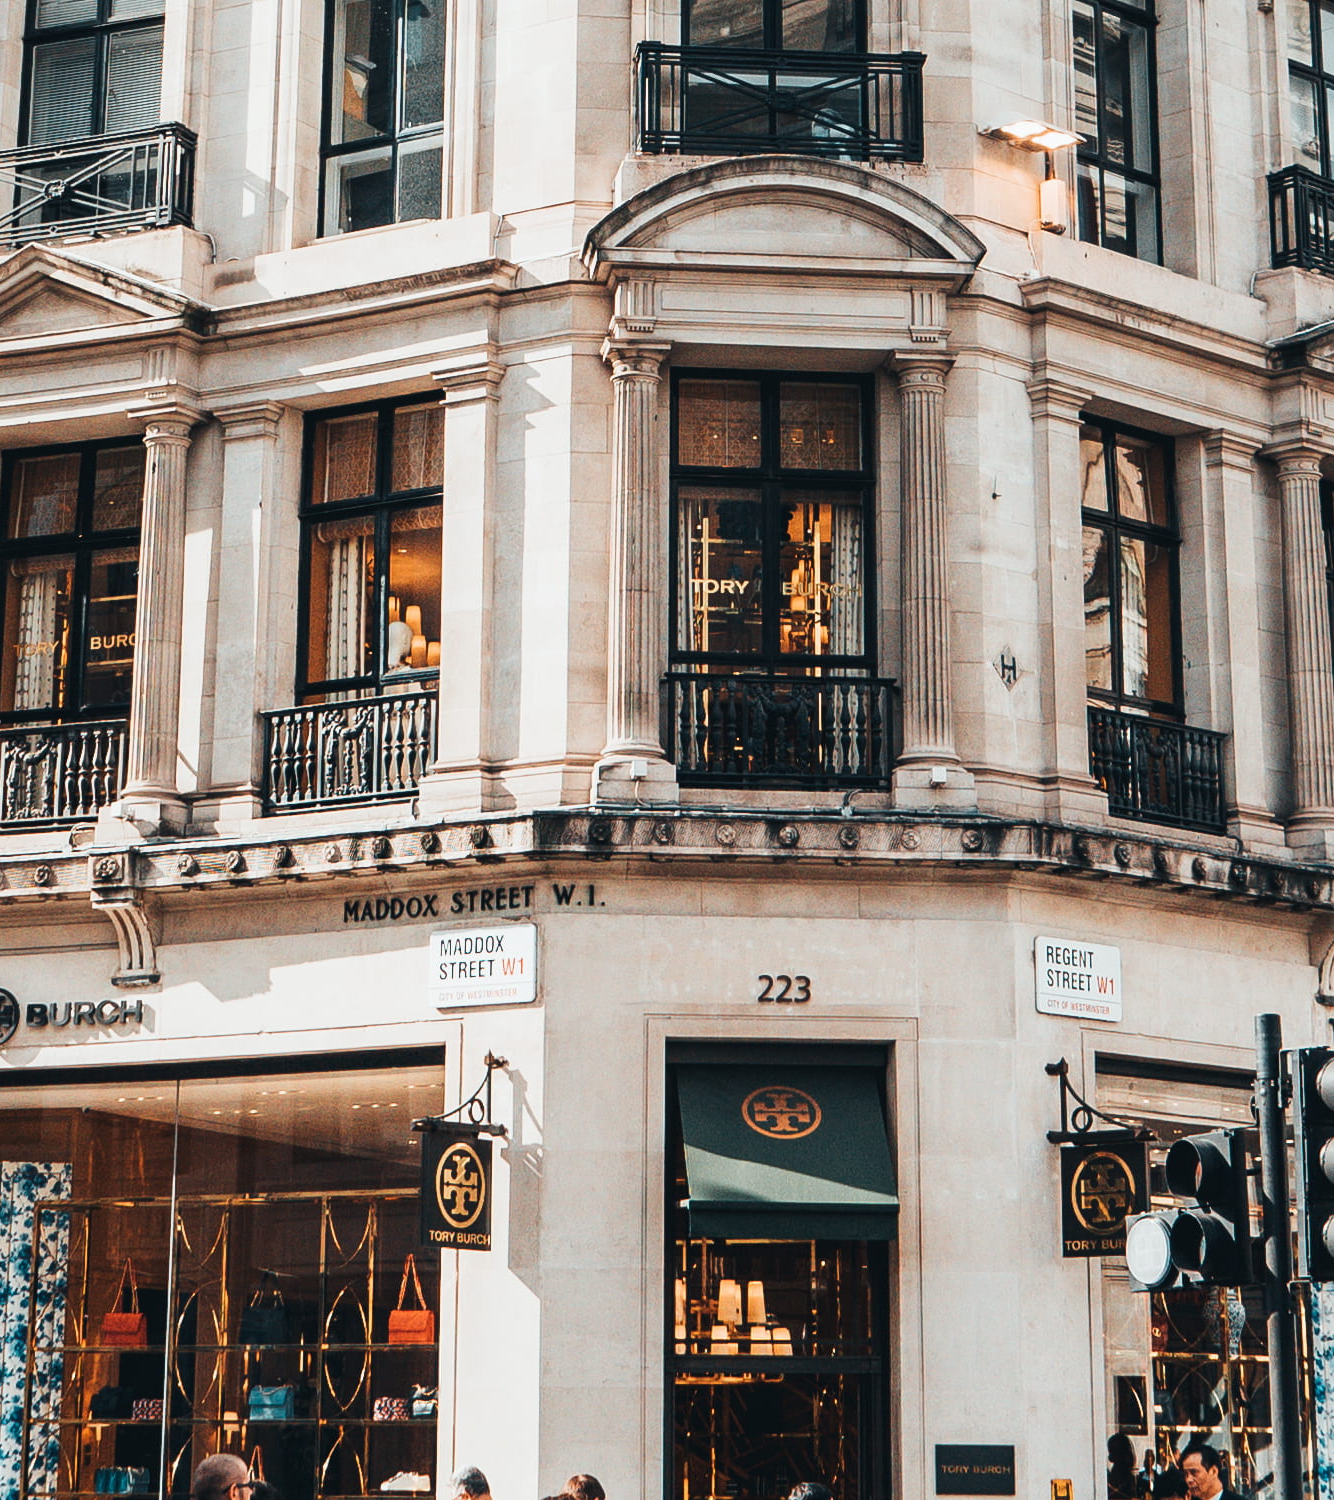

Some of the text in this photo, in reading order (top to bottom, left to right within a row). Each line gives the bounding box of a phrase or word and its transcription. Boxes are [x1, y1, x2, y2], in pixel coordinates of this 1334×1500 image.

[690, 578, 864, 598] TORY BURCH
[13, 633, 136, 657] TORY BURC
[1001, 654, 1017, 681] H
[343, 894, 439, 923] MADDOX
[450, 885, 535, 914] STREET
[440, 935, 504, 957] MADDOX
[1046, 945, 1094, 969] REGENT
[439, 957, 524, 980] STREET W1
[757, 974, 812, 1003] 223
[1047, 968, 1114, 995] STREET W1
[439, 987, 517, 1001] CITY OF WESTMINSTER
[26, 999, 143, 1028] BURCH
[1048, 999, 1110, 1015] CITY OF WESTMINSTER
[429, 1229, 491, 1247] TORY BURCH
[1065, 1240, 1127, 1251] TORY BUR
[941, 1464, 1010, 1475] TORY BURCH
